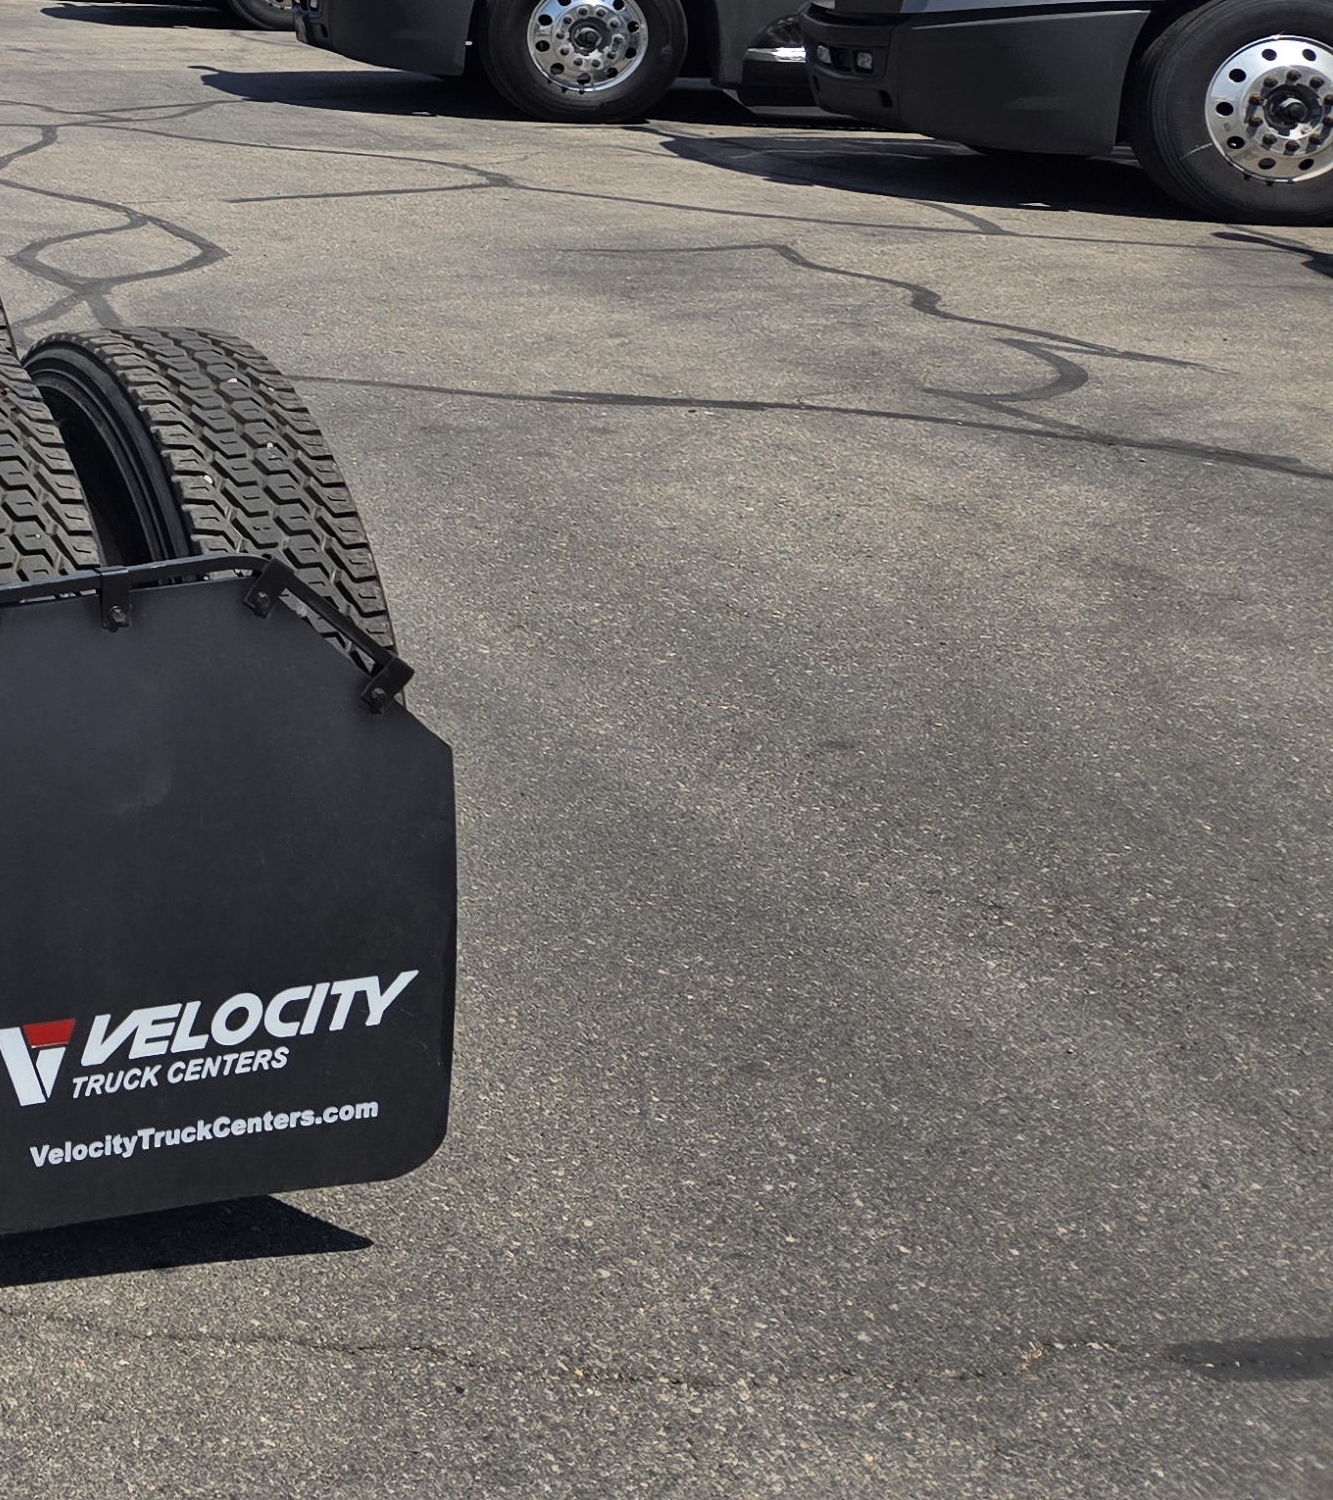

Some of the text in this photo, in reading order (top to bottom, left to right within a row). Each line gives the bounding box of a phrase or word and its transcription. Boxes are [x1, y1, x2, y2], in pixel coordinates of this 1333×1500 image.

[82, 970, 420, 1067] VELOCITY
[72, 1046, 290, 1099] TRUCK CENTERS
[29, 1101, 379, 1168] VelocityTruckCenters.com
